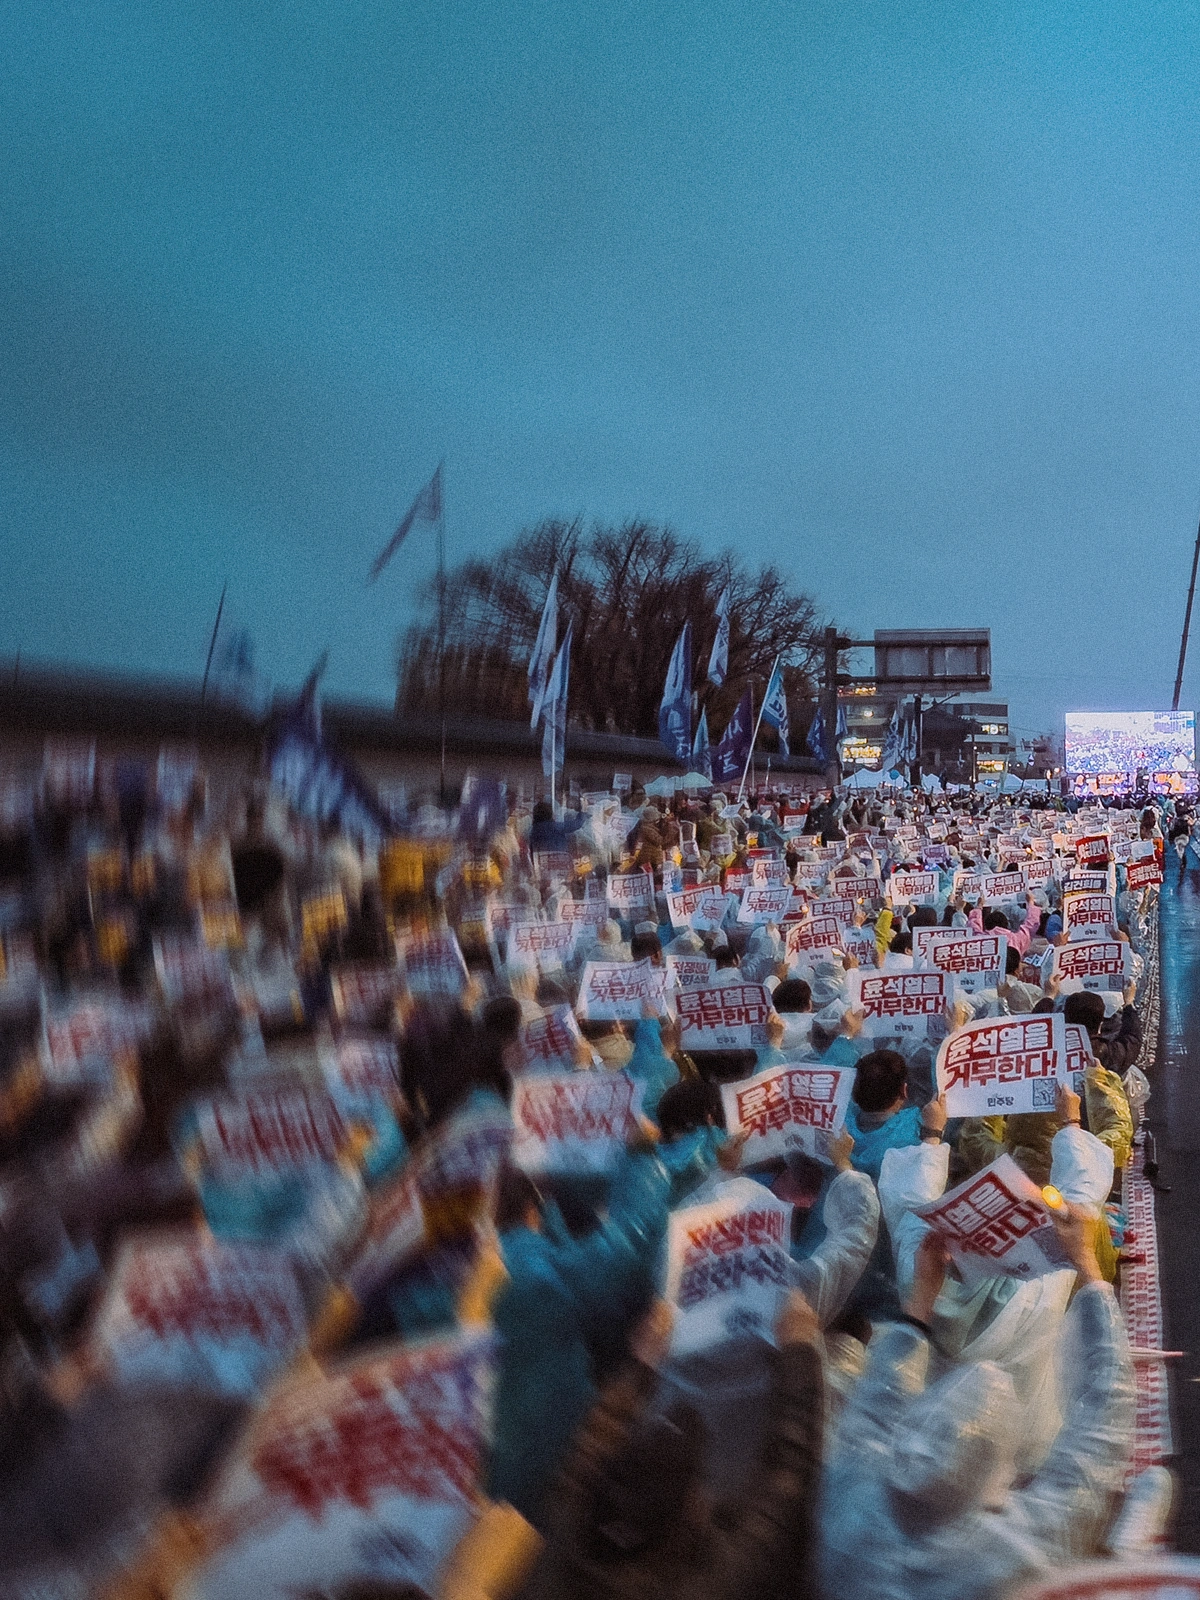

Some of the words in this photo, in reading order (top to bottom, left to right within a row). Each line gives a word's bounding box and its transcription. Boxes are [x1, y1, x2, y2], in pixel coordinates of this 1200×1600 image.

[896, 875, 933, 885] 윤석열을
[1068, 897, 1112, 916] 윤석열을
[934, 938, 998, 963] 윤석열을
[1061, 944, 1122, 966] 윤석열을
[1060, 961, 1124, 980] 거부한다!
[676, 985, 766, 1013] 윤석열을
[862, 974, 943, 1000] 윤석열을
[863, 996, 947, 1019] 거부한다!
[946, 1020, 1052, 1067] 윤석열을
[945, 1051, 1059, 1091] 거부한다!
[738, 1071, 841, 1123] 윤석열을
[987, 1096, 1015, 1108] 민주당
